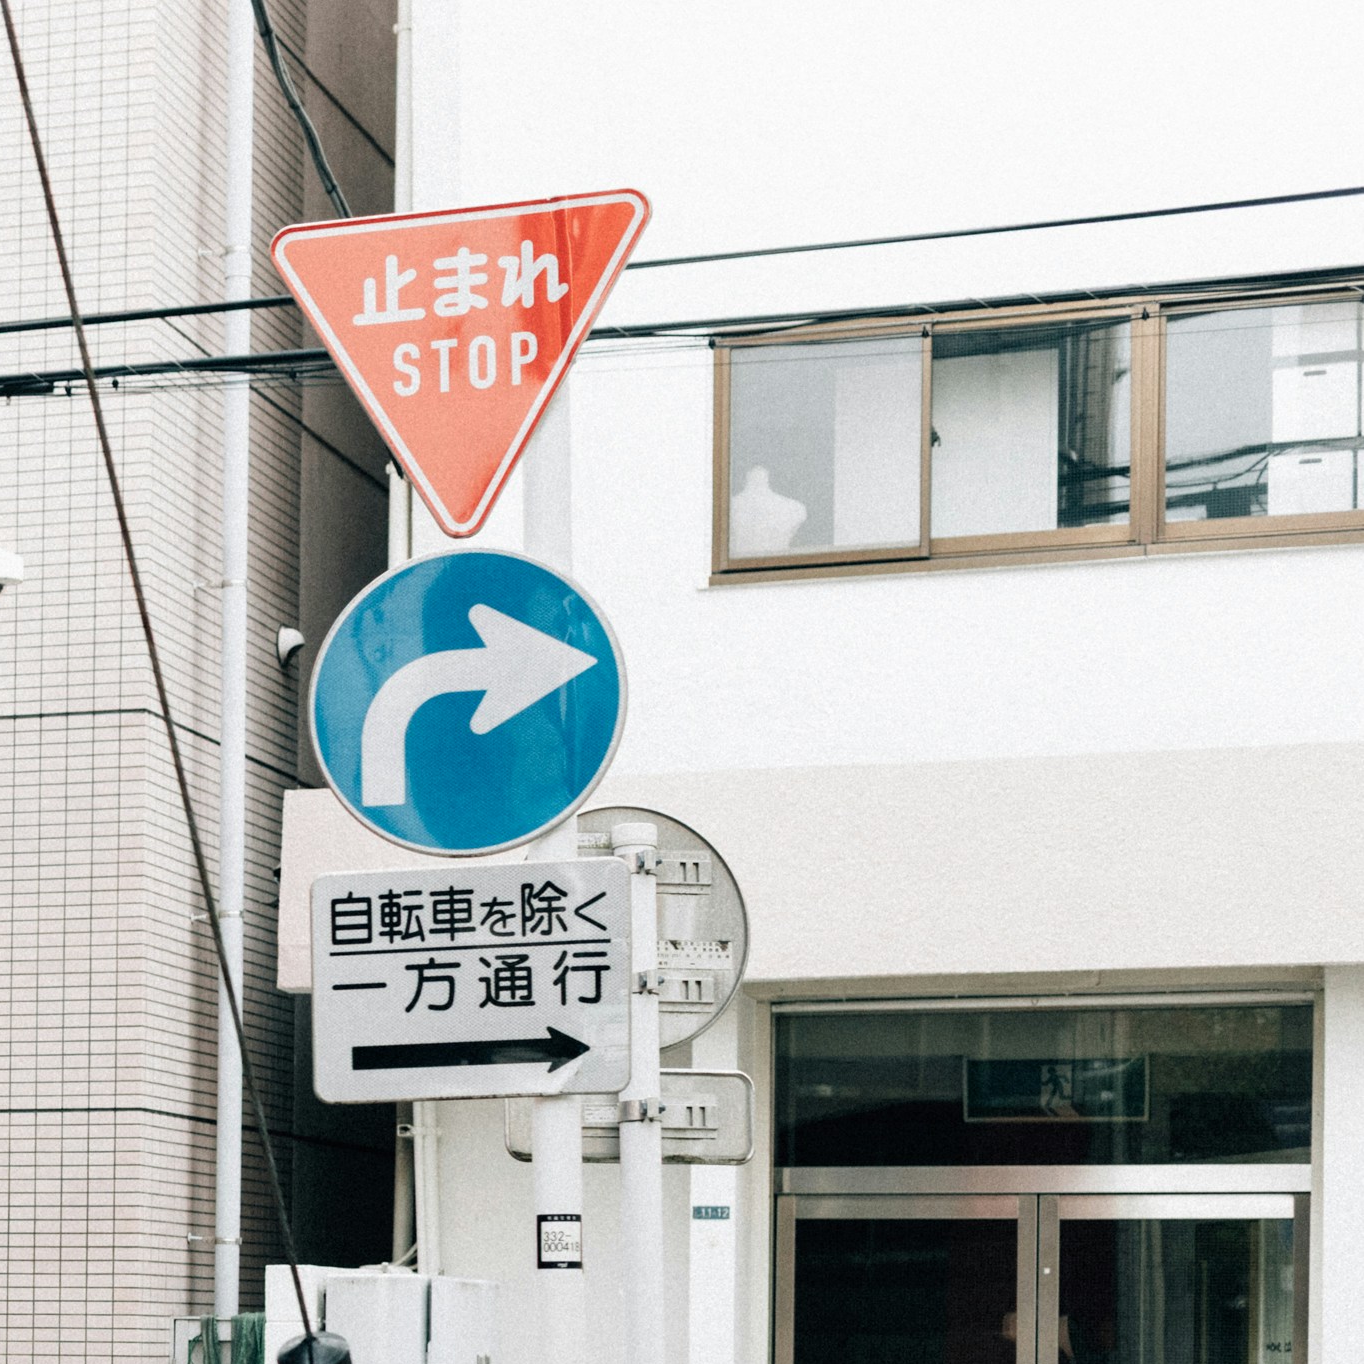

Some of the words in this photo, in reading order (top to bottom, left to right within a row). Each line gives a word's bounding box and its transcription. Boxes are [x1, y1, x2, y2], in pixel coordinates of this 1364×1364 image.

[352, 239, 570, 326] 止まれ
[393, 331, 538, 397] STOP
[331, 880, 608, 945] 自転車を除く
[332, 950, 611, 1013] 一方通行
